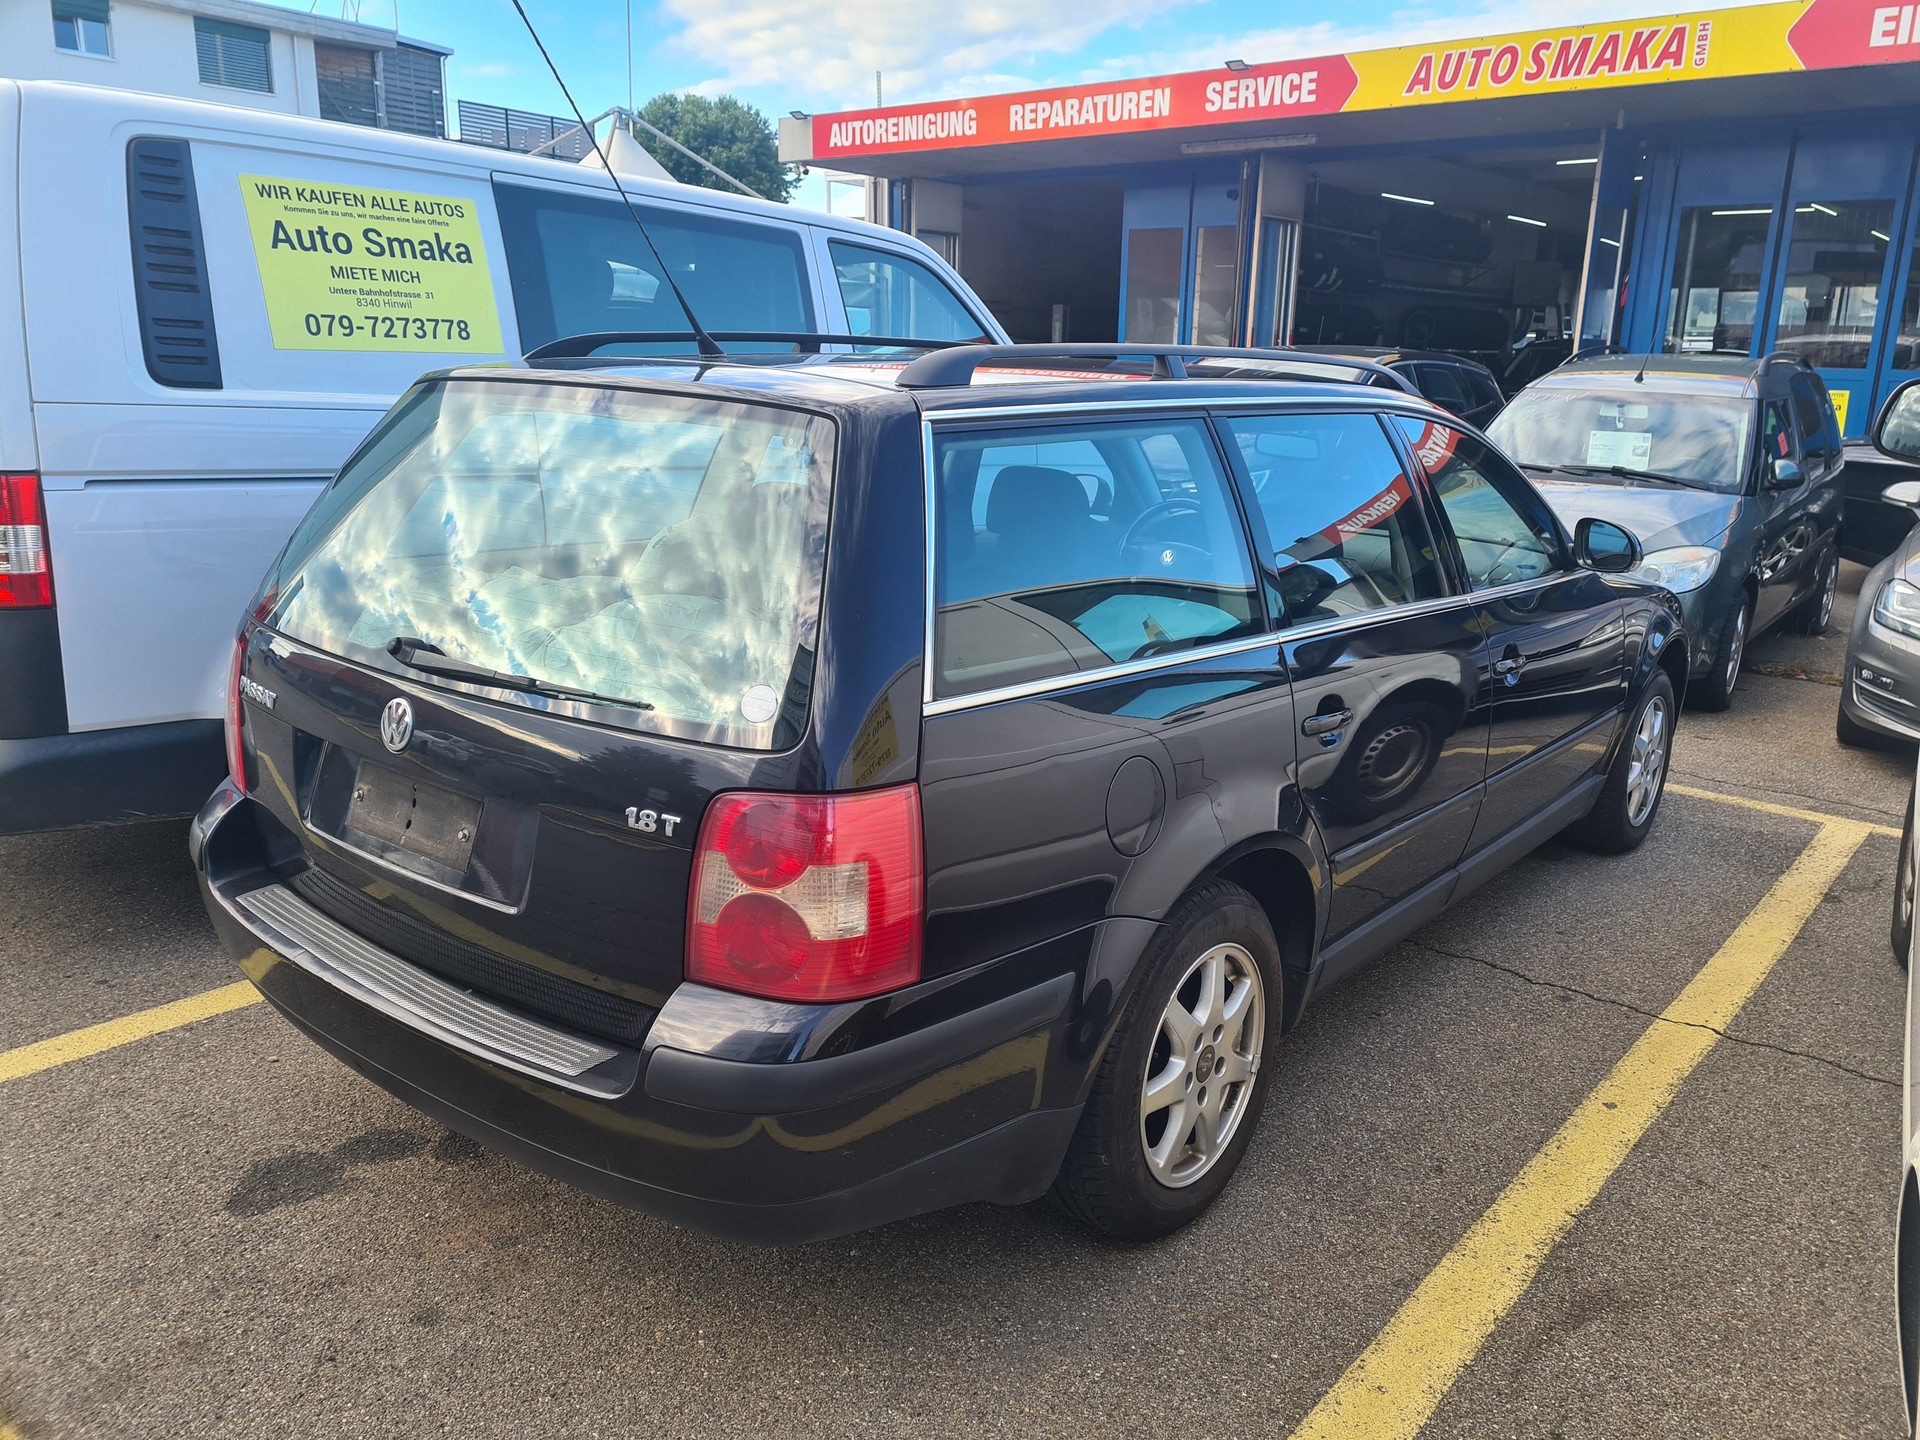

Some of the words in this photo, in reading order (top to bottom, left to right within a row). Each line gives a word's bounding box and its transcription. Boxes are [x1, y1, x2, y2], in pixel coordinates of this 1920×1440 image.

[1694, 22, 1710, 67] GMBH
[1869, 3, 1920, 48] EI
[1404, 44, 1518, 95] AUTO
[1523, 25, 1689, 82] SMAKA
[1009, 87, 1171, 133] REPARATUREN
[1204, 71, 1318, 113] SERVICE
[828, 109, 977, 148] AUTOREINIGUNG
[254, 182, 292, 201] WIR
[295, 187, 366, 208] KAUFEN
[371, 195, 410, 213] ALLE
[414, 200, 465, 219] AUTOS
[283, 204, 317, 215] Kommen
[317, 207, 329, 216] Sie
[368, 214, 395, 222] machen
[411, 216, 426, 225] faire
[427, 218, 449, 227] Offerte
[271, 219, 353, 255] Auto
[361, 227, 473, 264] Smaka
[328, 286, 357, 295] Untere
[358, 288, 421, 299] Bahnhofstrasse
[424, 291, 434, 299] 31
[330, 265, 379, 281] MIETE
[381, 268, 421, 284] MICH
[356, 297, 380, 308] 8340
[382, 298, 413, 309] Hinwil
[304, 313, 471, 341] 079-7273778
[239, 674, 278, 710] PASSAT
